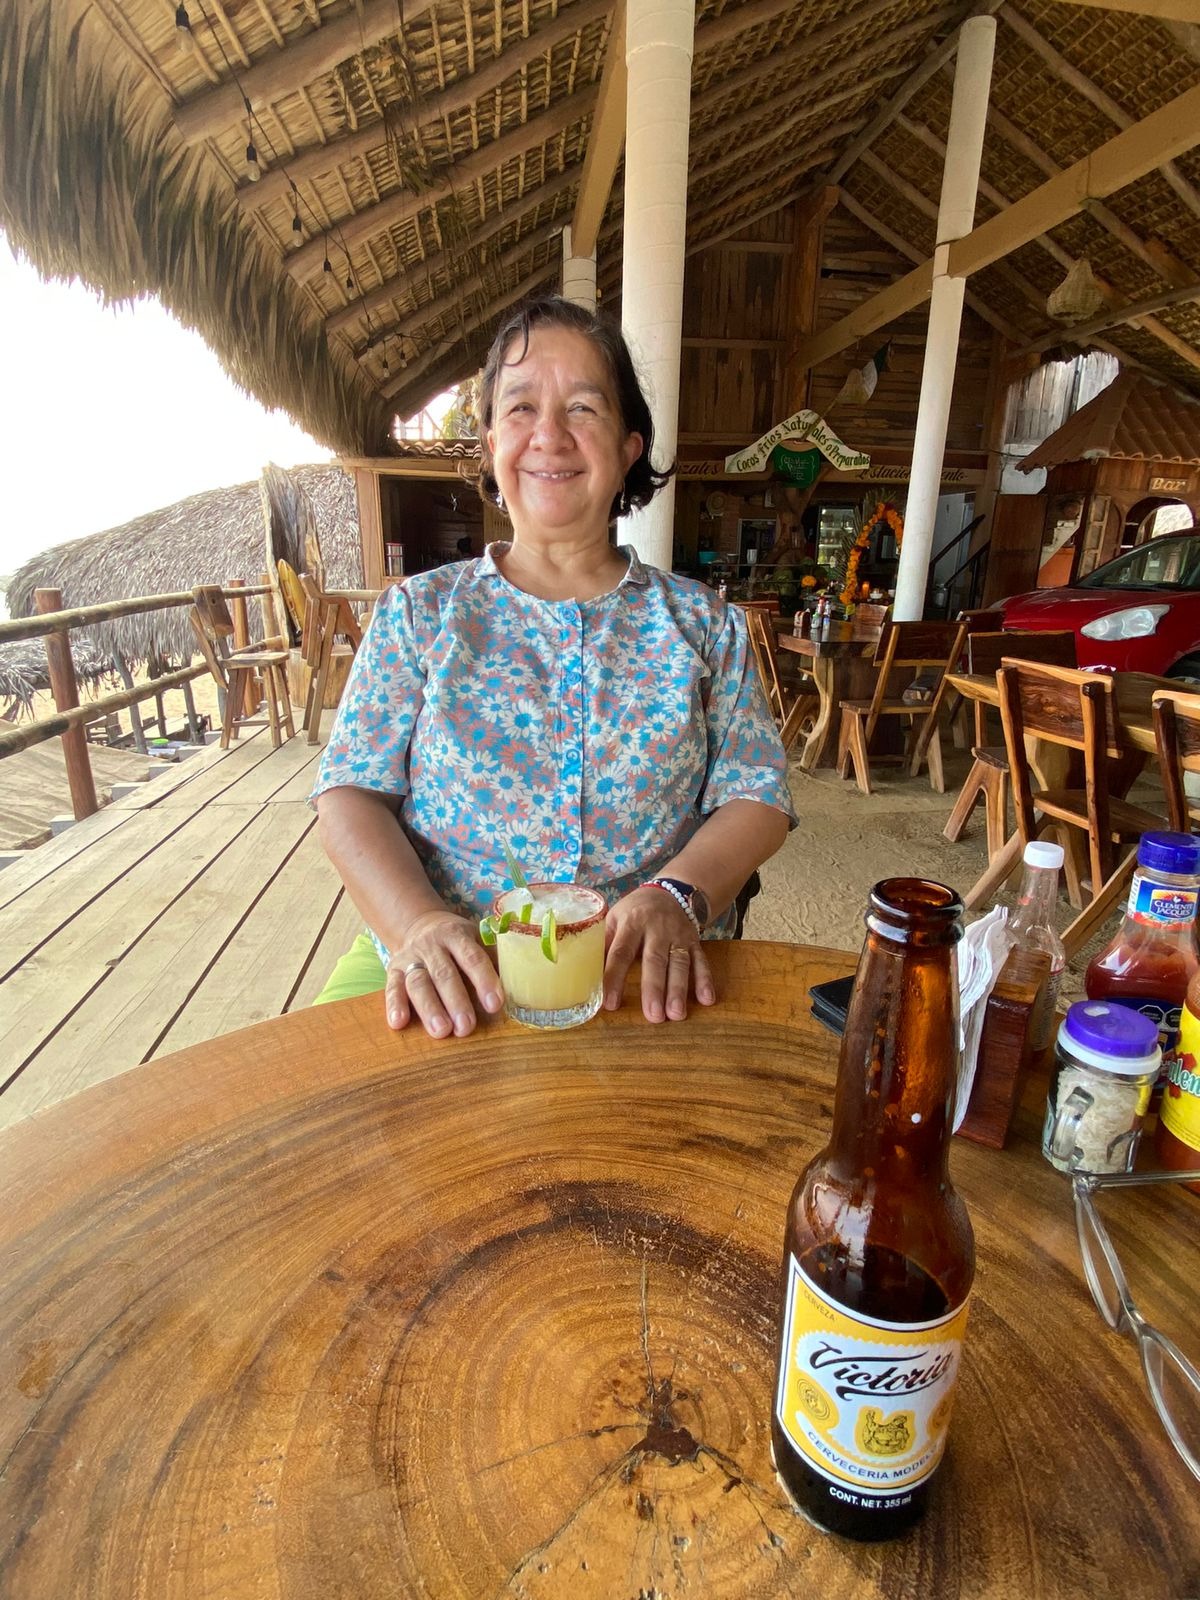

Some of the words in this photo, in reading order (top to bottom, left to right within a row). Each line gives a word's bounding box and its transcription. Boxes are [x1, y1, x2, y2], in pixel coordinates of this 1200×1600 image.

[736, 453, 760, 472] Cocos
[828, 445, 870, 468] Preparados
[1152, 477, 1186, 491] Bar
[1154, 899, 1193, 911] CLEMENTE
[1156, 906, 1191, 918] JACQUES
[803, 1289, 836, 1322] CERVEZA
[809, 1341, 955, 1401] Victoria
[808, 1431, 889, 1479] CERVECERIA
[829, 1486, 859, 1506] CONT.
[861, 1497, 883, 1509] NET.
[884, 1499, 901, 1509] 355
[901, 1494, 912, 1505] ml
